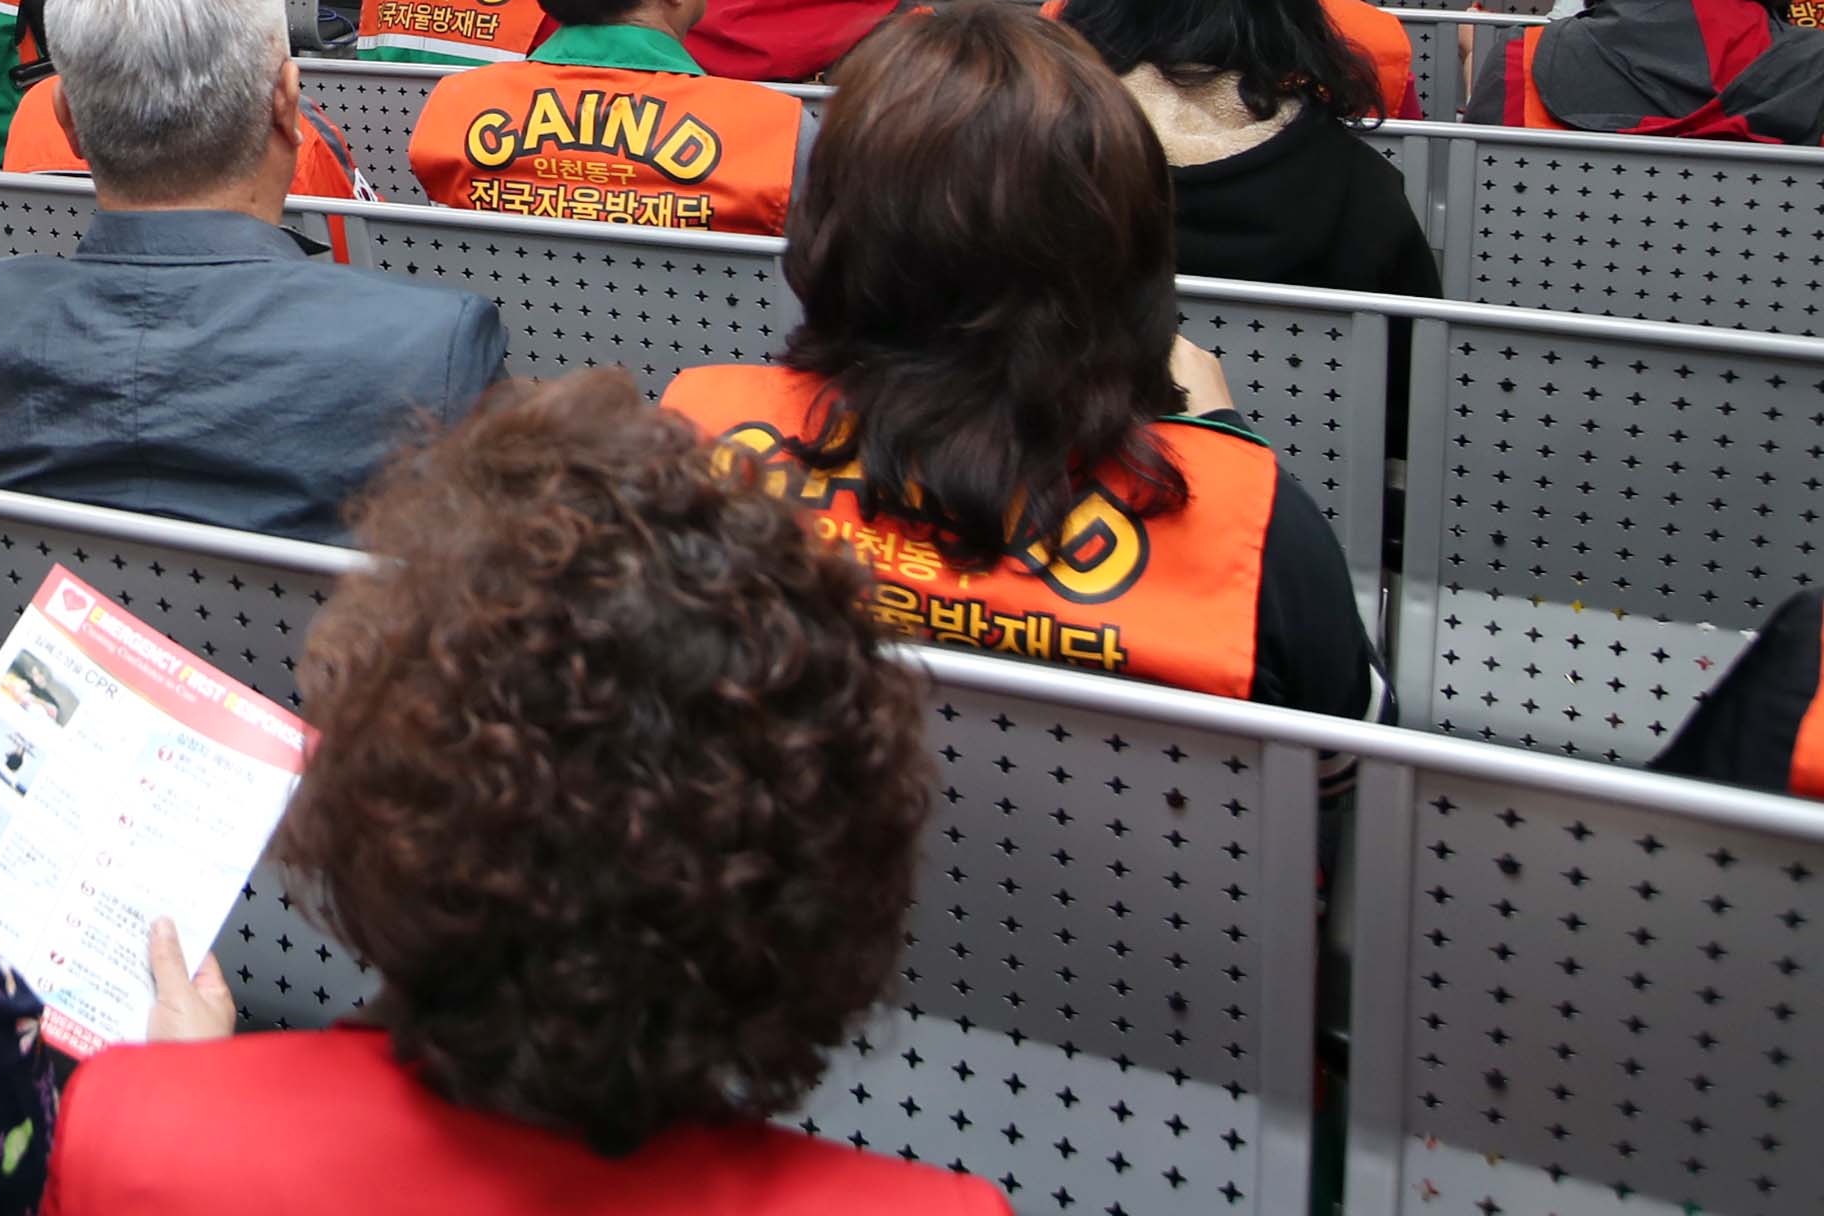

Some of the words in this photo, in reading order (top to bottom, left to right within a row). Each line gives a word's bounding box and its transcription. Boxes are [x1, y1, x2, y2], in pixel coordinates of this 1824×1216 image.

[465, 87, 722, 185] CAIND
[533, 157, 637, 185] 인천동구
[469, 178, 714, 231] 전국자율방재단
[85, 669, 118, 700] CPR
